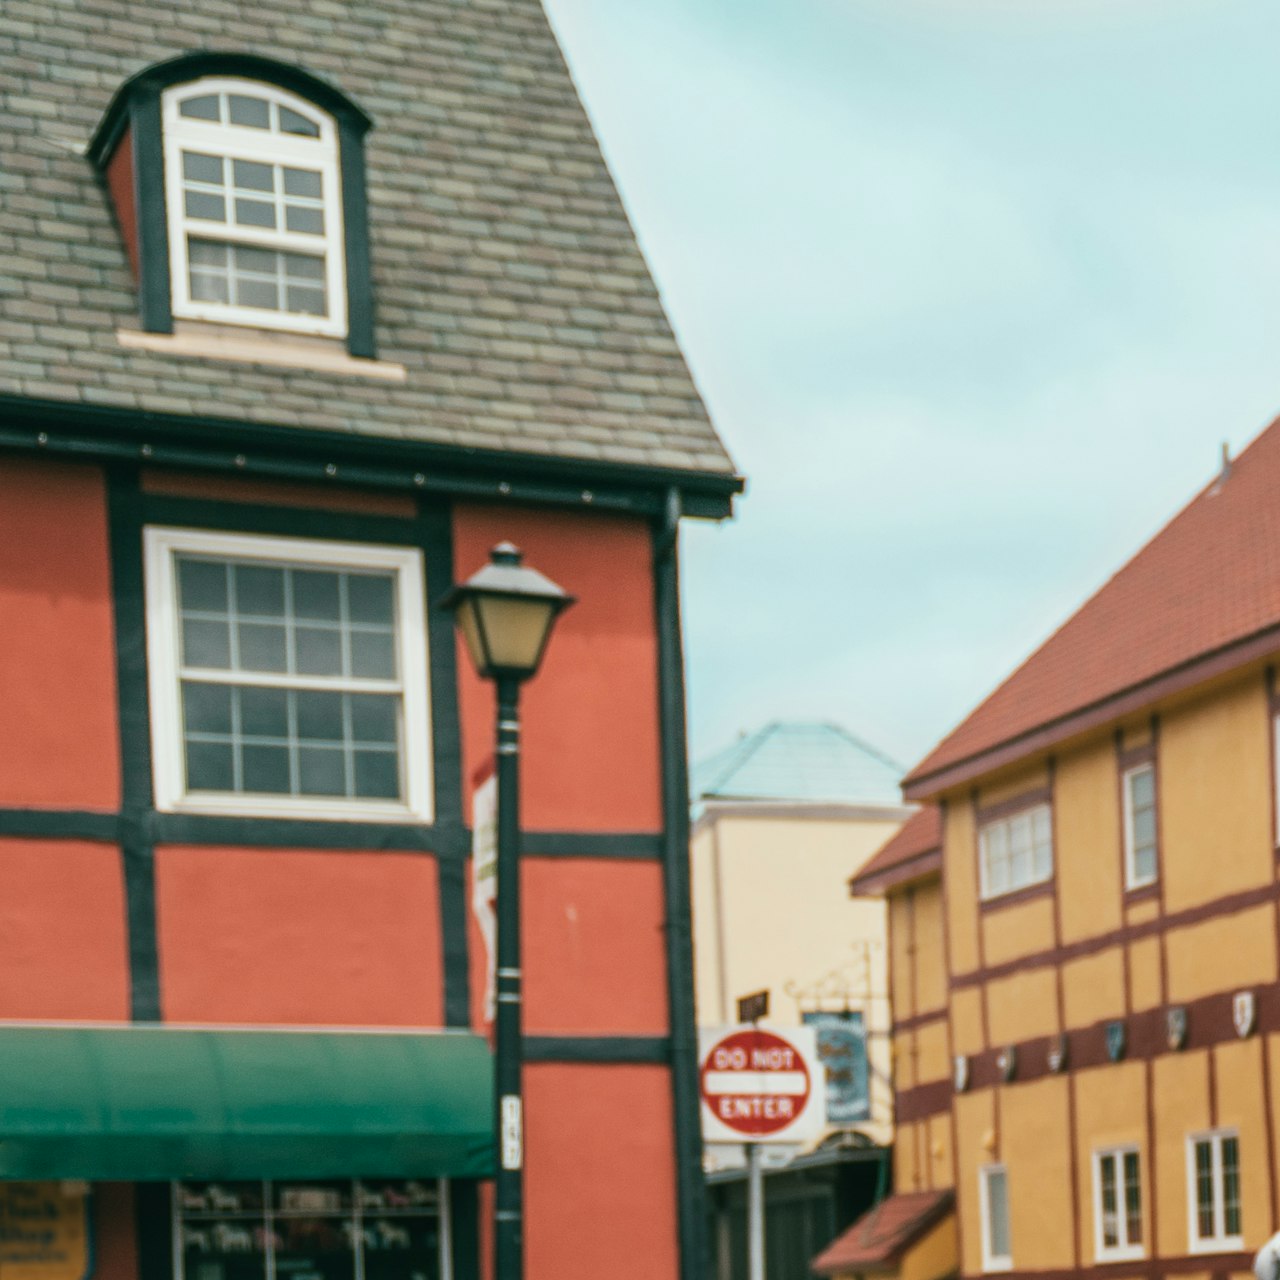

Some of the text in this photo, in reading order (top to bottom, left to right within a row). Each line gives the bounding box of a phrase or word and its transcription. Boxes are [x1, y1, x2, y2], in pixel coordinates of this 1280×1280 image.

[714, 1047, 794, 1070] DO NOT
[719, 1098, 793, 1119] ENTER
